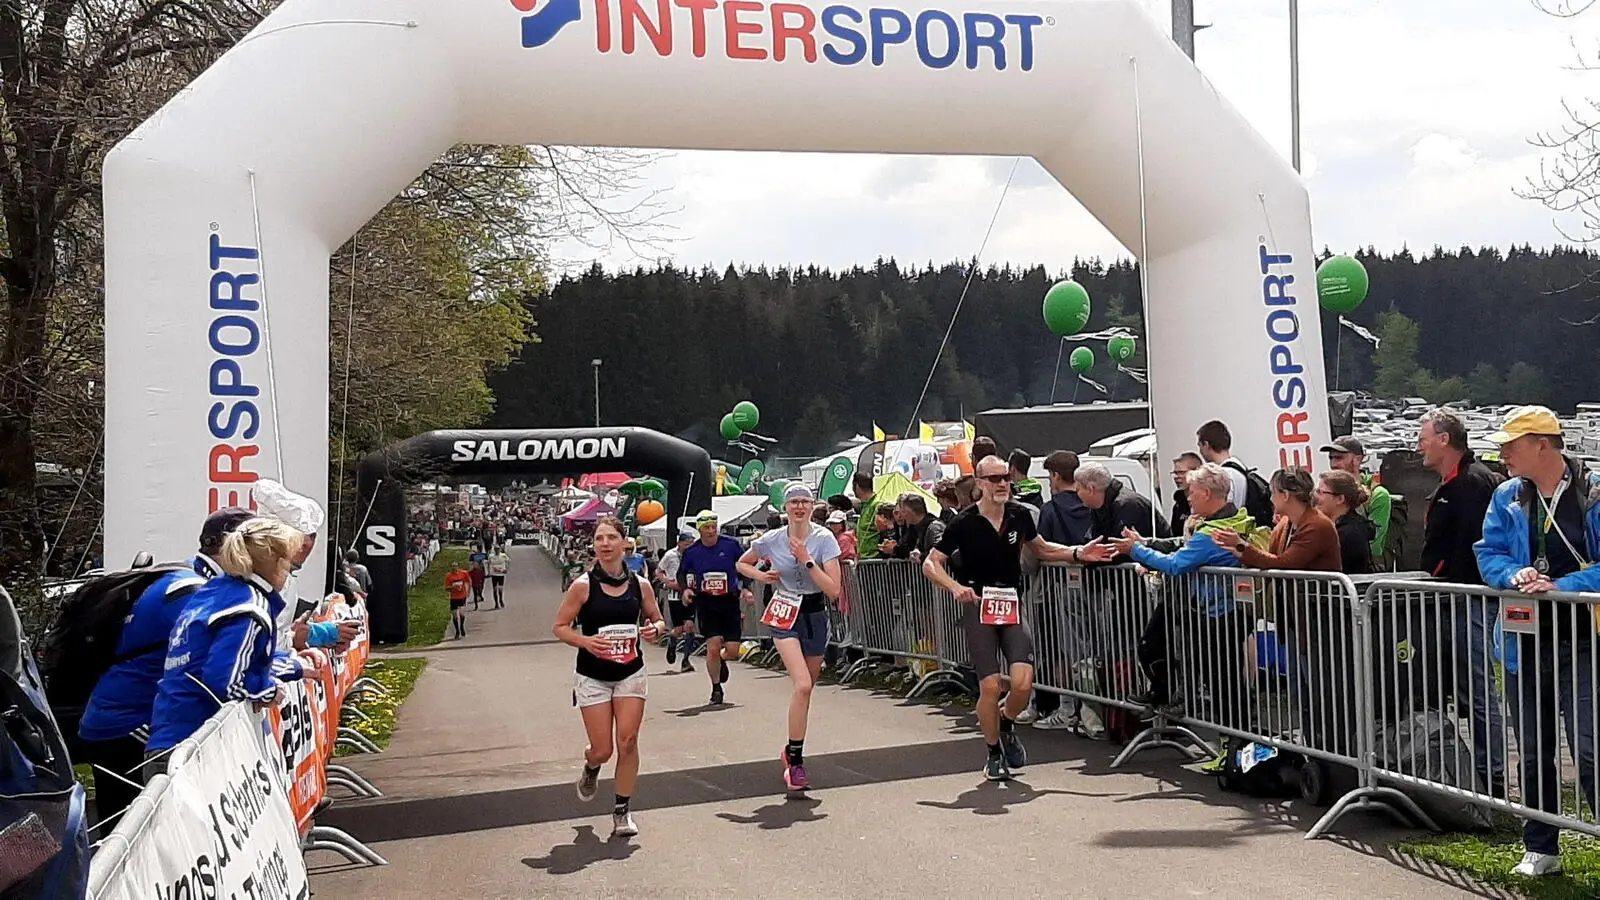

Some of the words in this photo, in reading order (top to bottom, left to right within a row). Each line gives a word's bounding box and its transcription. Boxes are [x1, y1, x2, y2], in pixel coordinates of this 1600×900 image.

[595, 0, 1043, 72] INTERSPORT
[451, 436, 626, 462] SALOMON
[366, 526, 396, 556] S
[987, 600, 1012, 616] 5139
